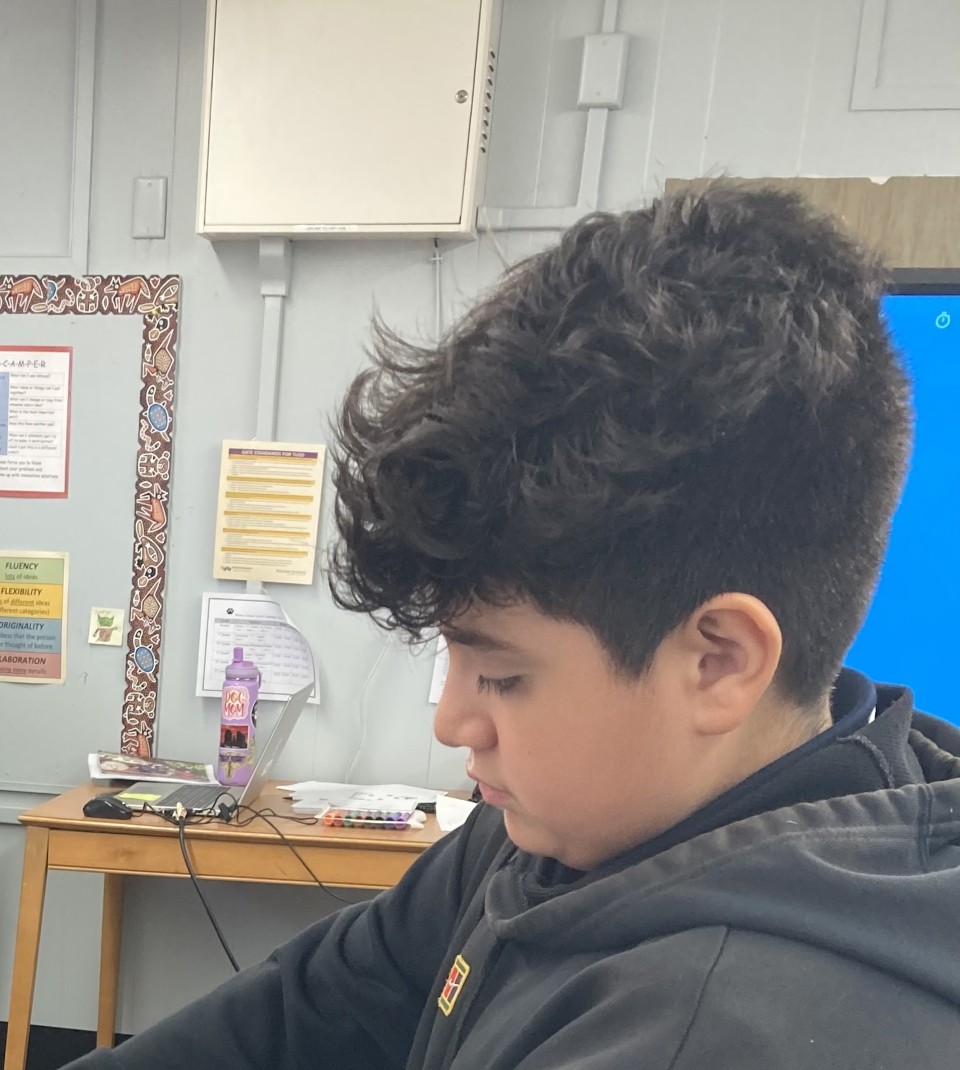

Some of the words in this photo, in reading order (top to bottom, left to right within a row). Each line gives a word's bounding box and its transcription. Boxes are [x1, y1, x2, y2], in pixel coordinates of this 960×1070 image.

[5, 562, 39, 570] FLUENCY
[1, 588, 42, 596] FLEXIBILITY
[225, 691, 246, 703] DOG
[224, 703, 244, 717] MOM
